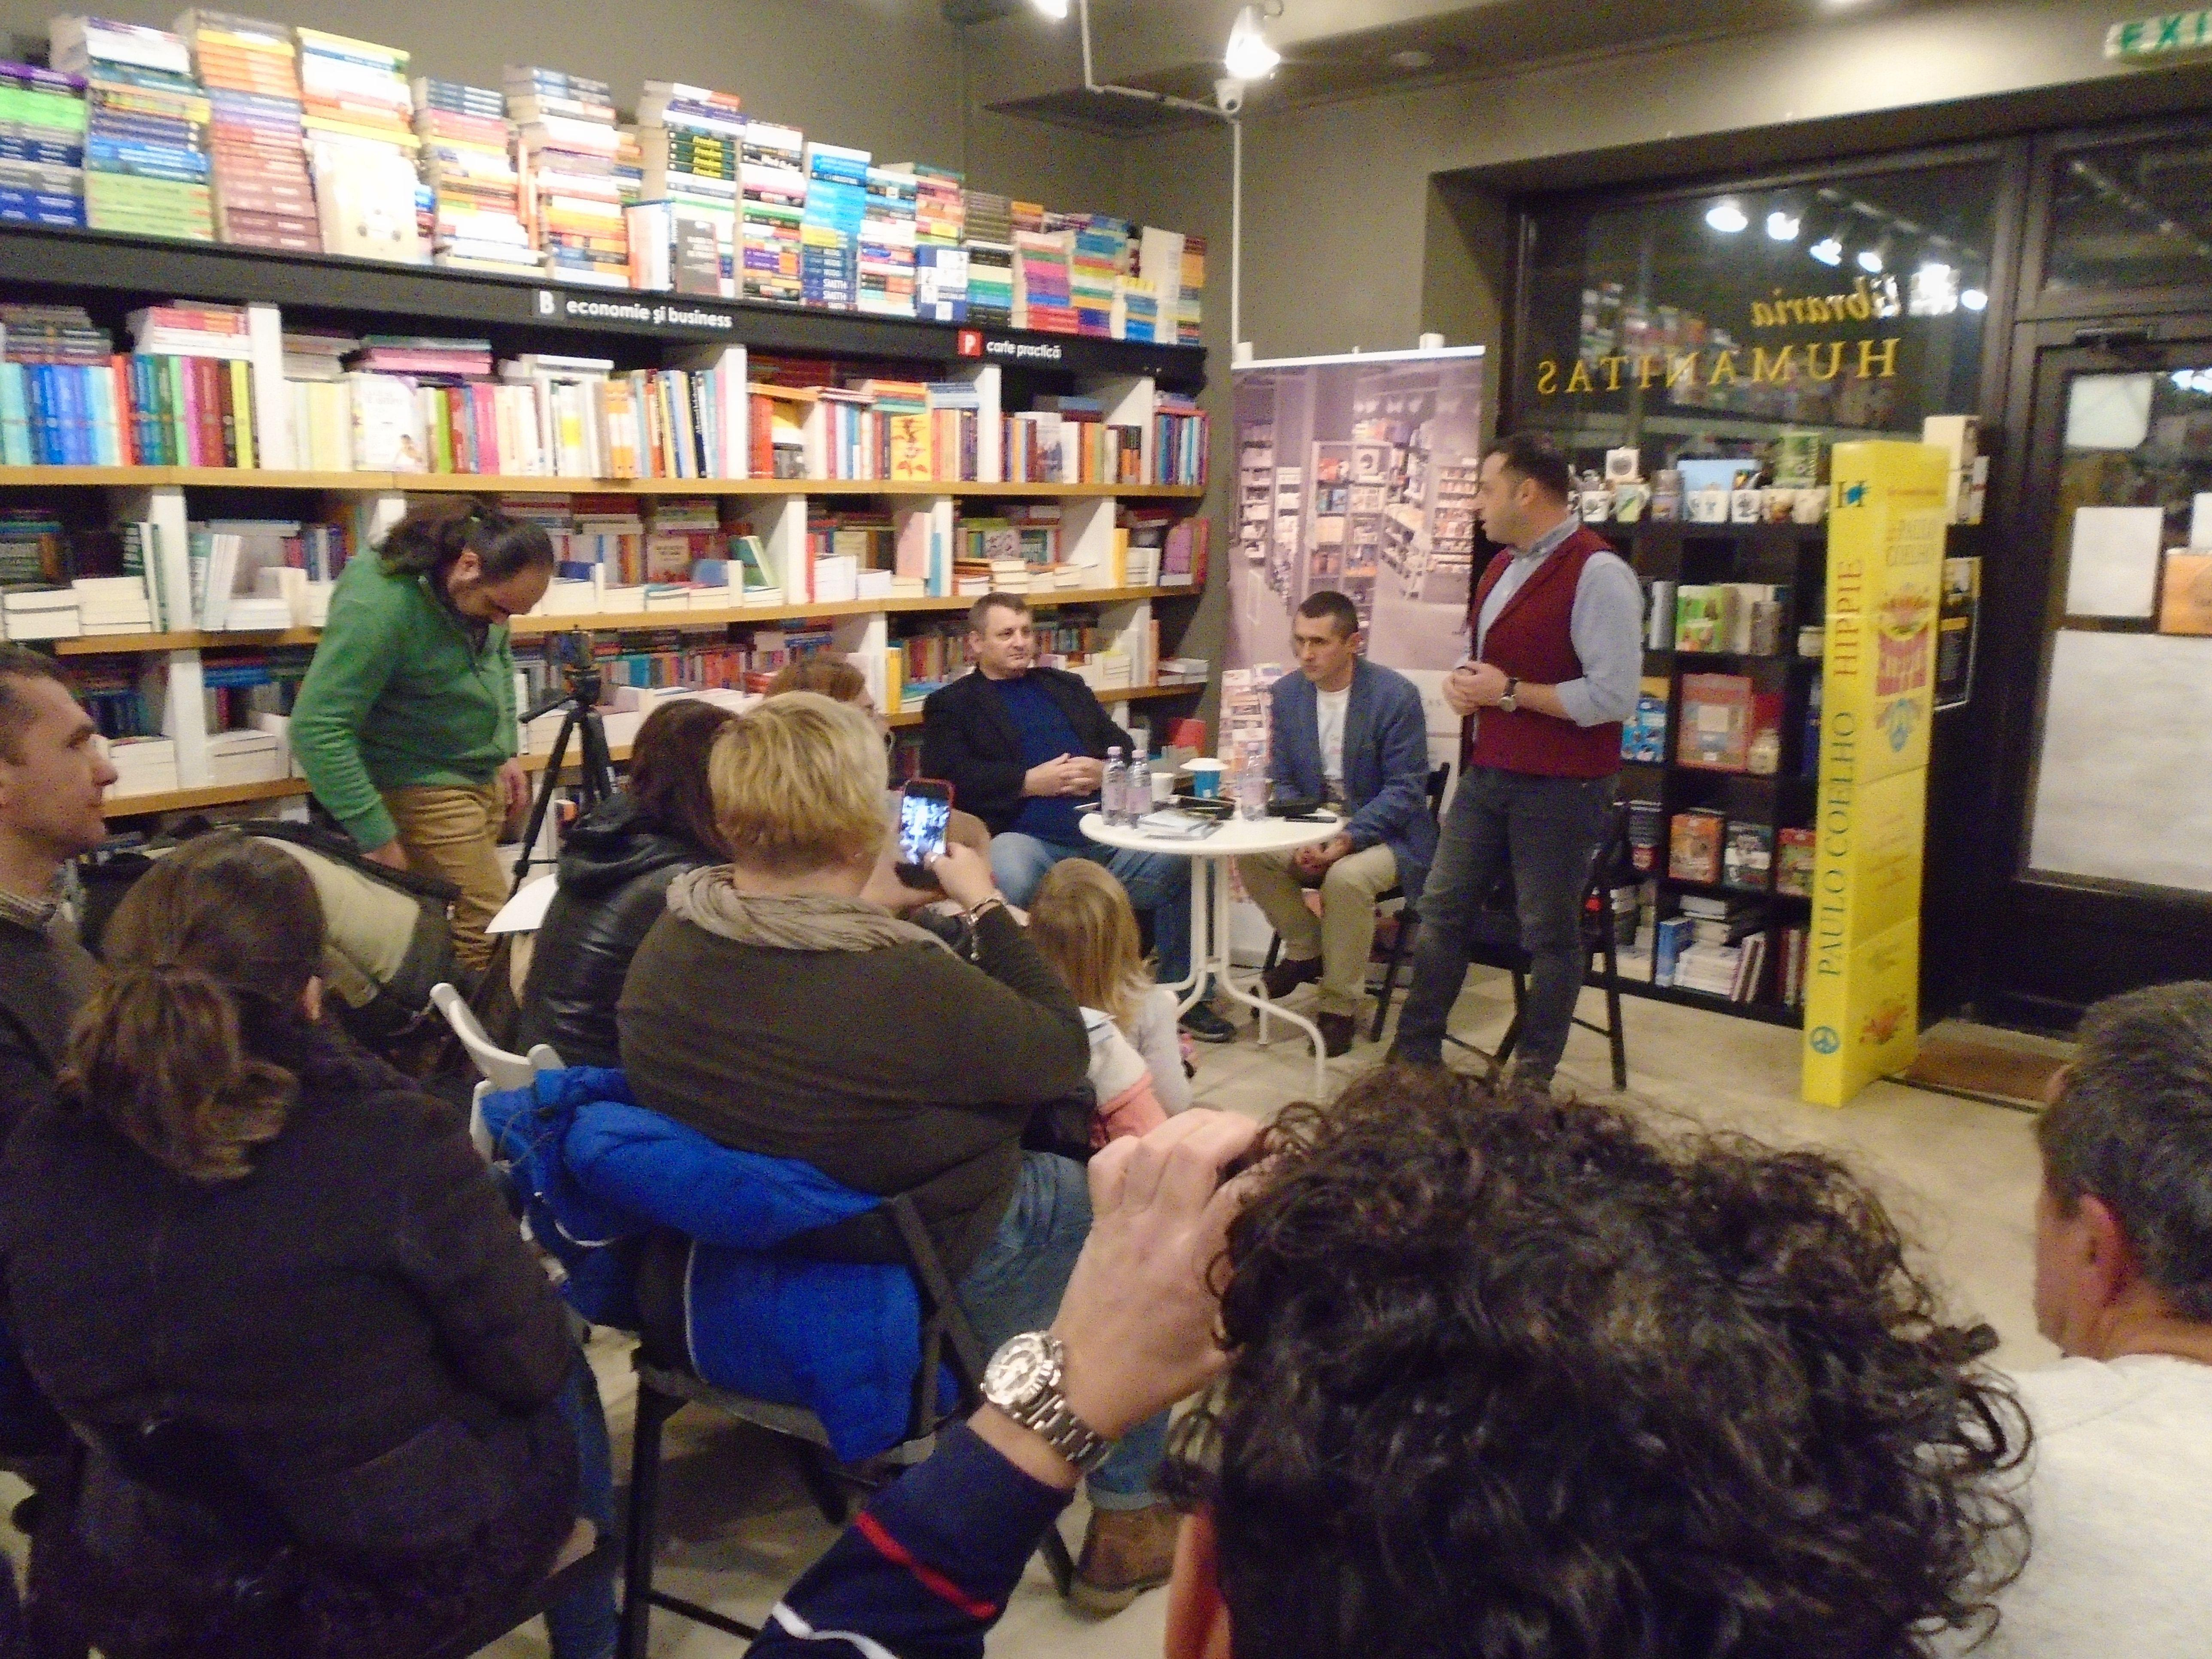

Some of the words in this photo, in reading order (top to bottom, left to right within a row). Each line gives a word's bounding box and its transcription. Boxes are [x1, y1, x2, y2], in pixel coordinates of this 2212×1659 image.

[539, 290, 555, 314] B
[566, 300, 650, 320] economie
[668, 307, 732, 328] business
[965, 334, 976, 354] P
[986, 340, 1016, 354] carte
[1017, 344, 1062, 359] practică
[1834, 559, 1863, 678] HIPPIE
[1824, 711, 1856, 858] COELHO
[1817, 869, 1846, 977] PAULO
